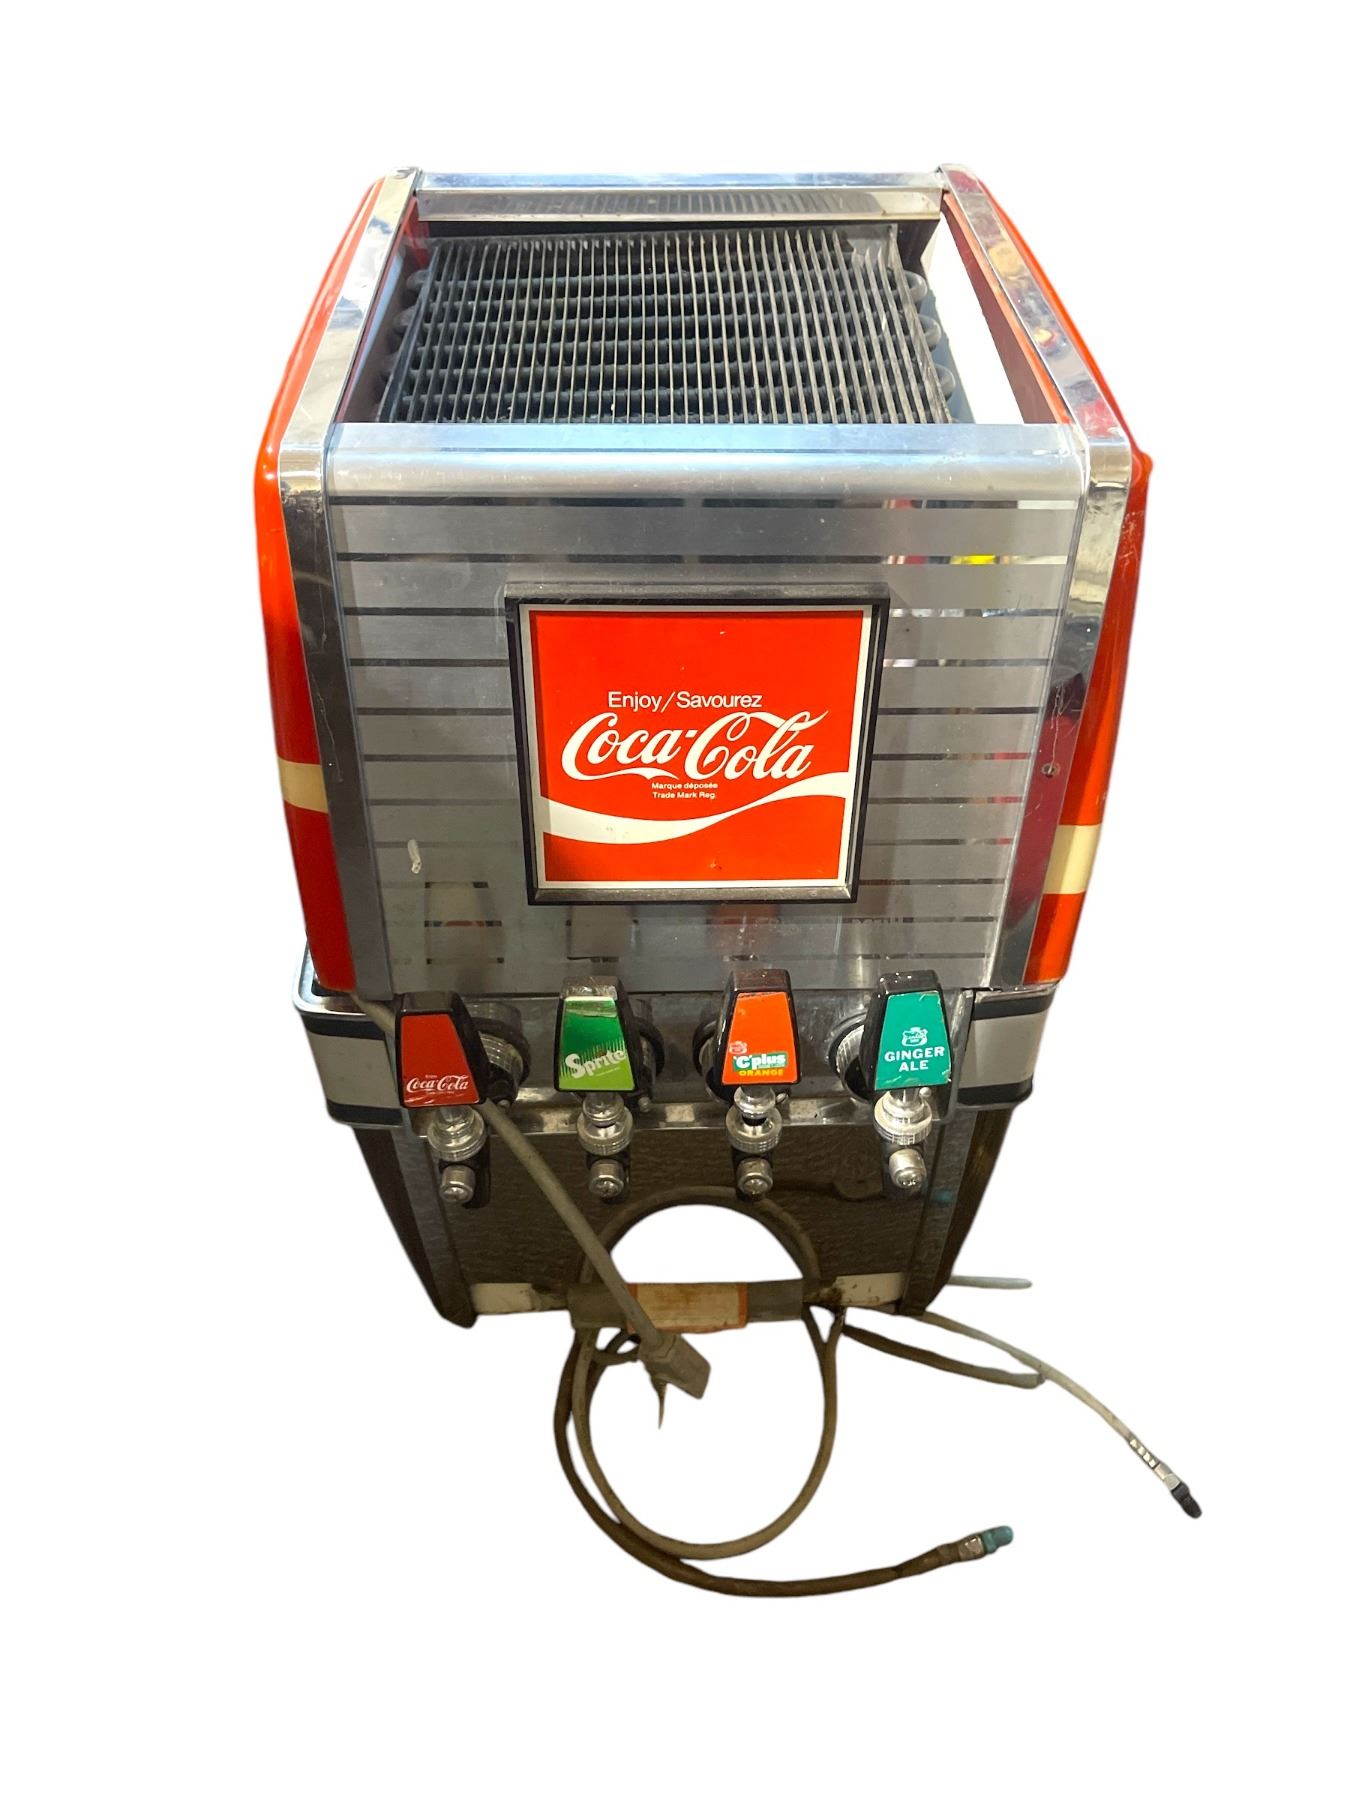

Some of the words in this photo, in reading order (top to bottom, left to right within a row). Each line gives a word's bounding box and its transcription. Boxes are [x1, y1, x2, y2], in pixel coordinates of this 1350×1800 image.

[608, 691, 762, 713] Enjoy/Savourez
[561, 710, 829, 780] Coca-Cola
[651, 782, 682, 790] Marque
[653, 791, 676, 799] Trade
[677, 791, 697, 799] Mark
[884, 1046, 945, 1062] GINGER
[565, 1050, 626, 1079] Sprite
[899, 1060, 929, 1072] ALE
[739, 1069, 784, 1077] ORANGE
[406, 1075, 469, 1093] Coca-Cola
